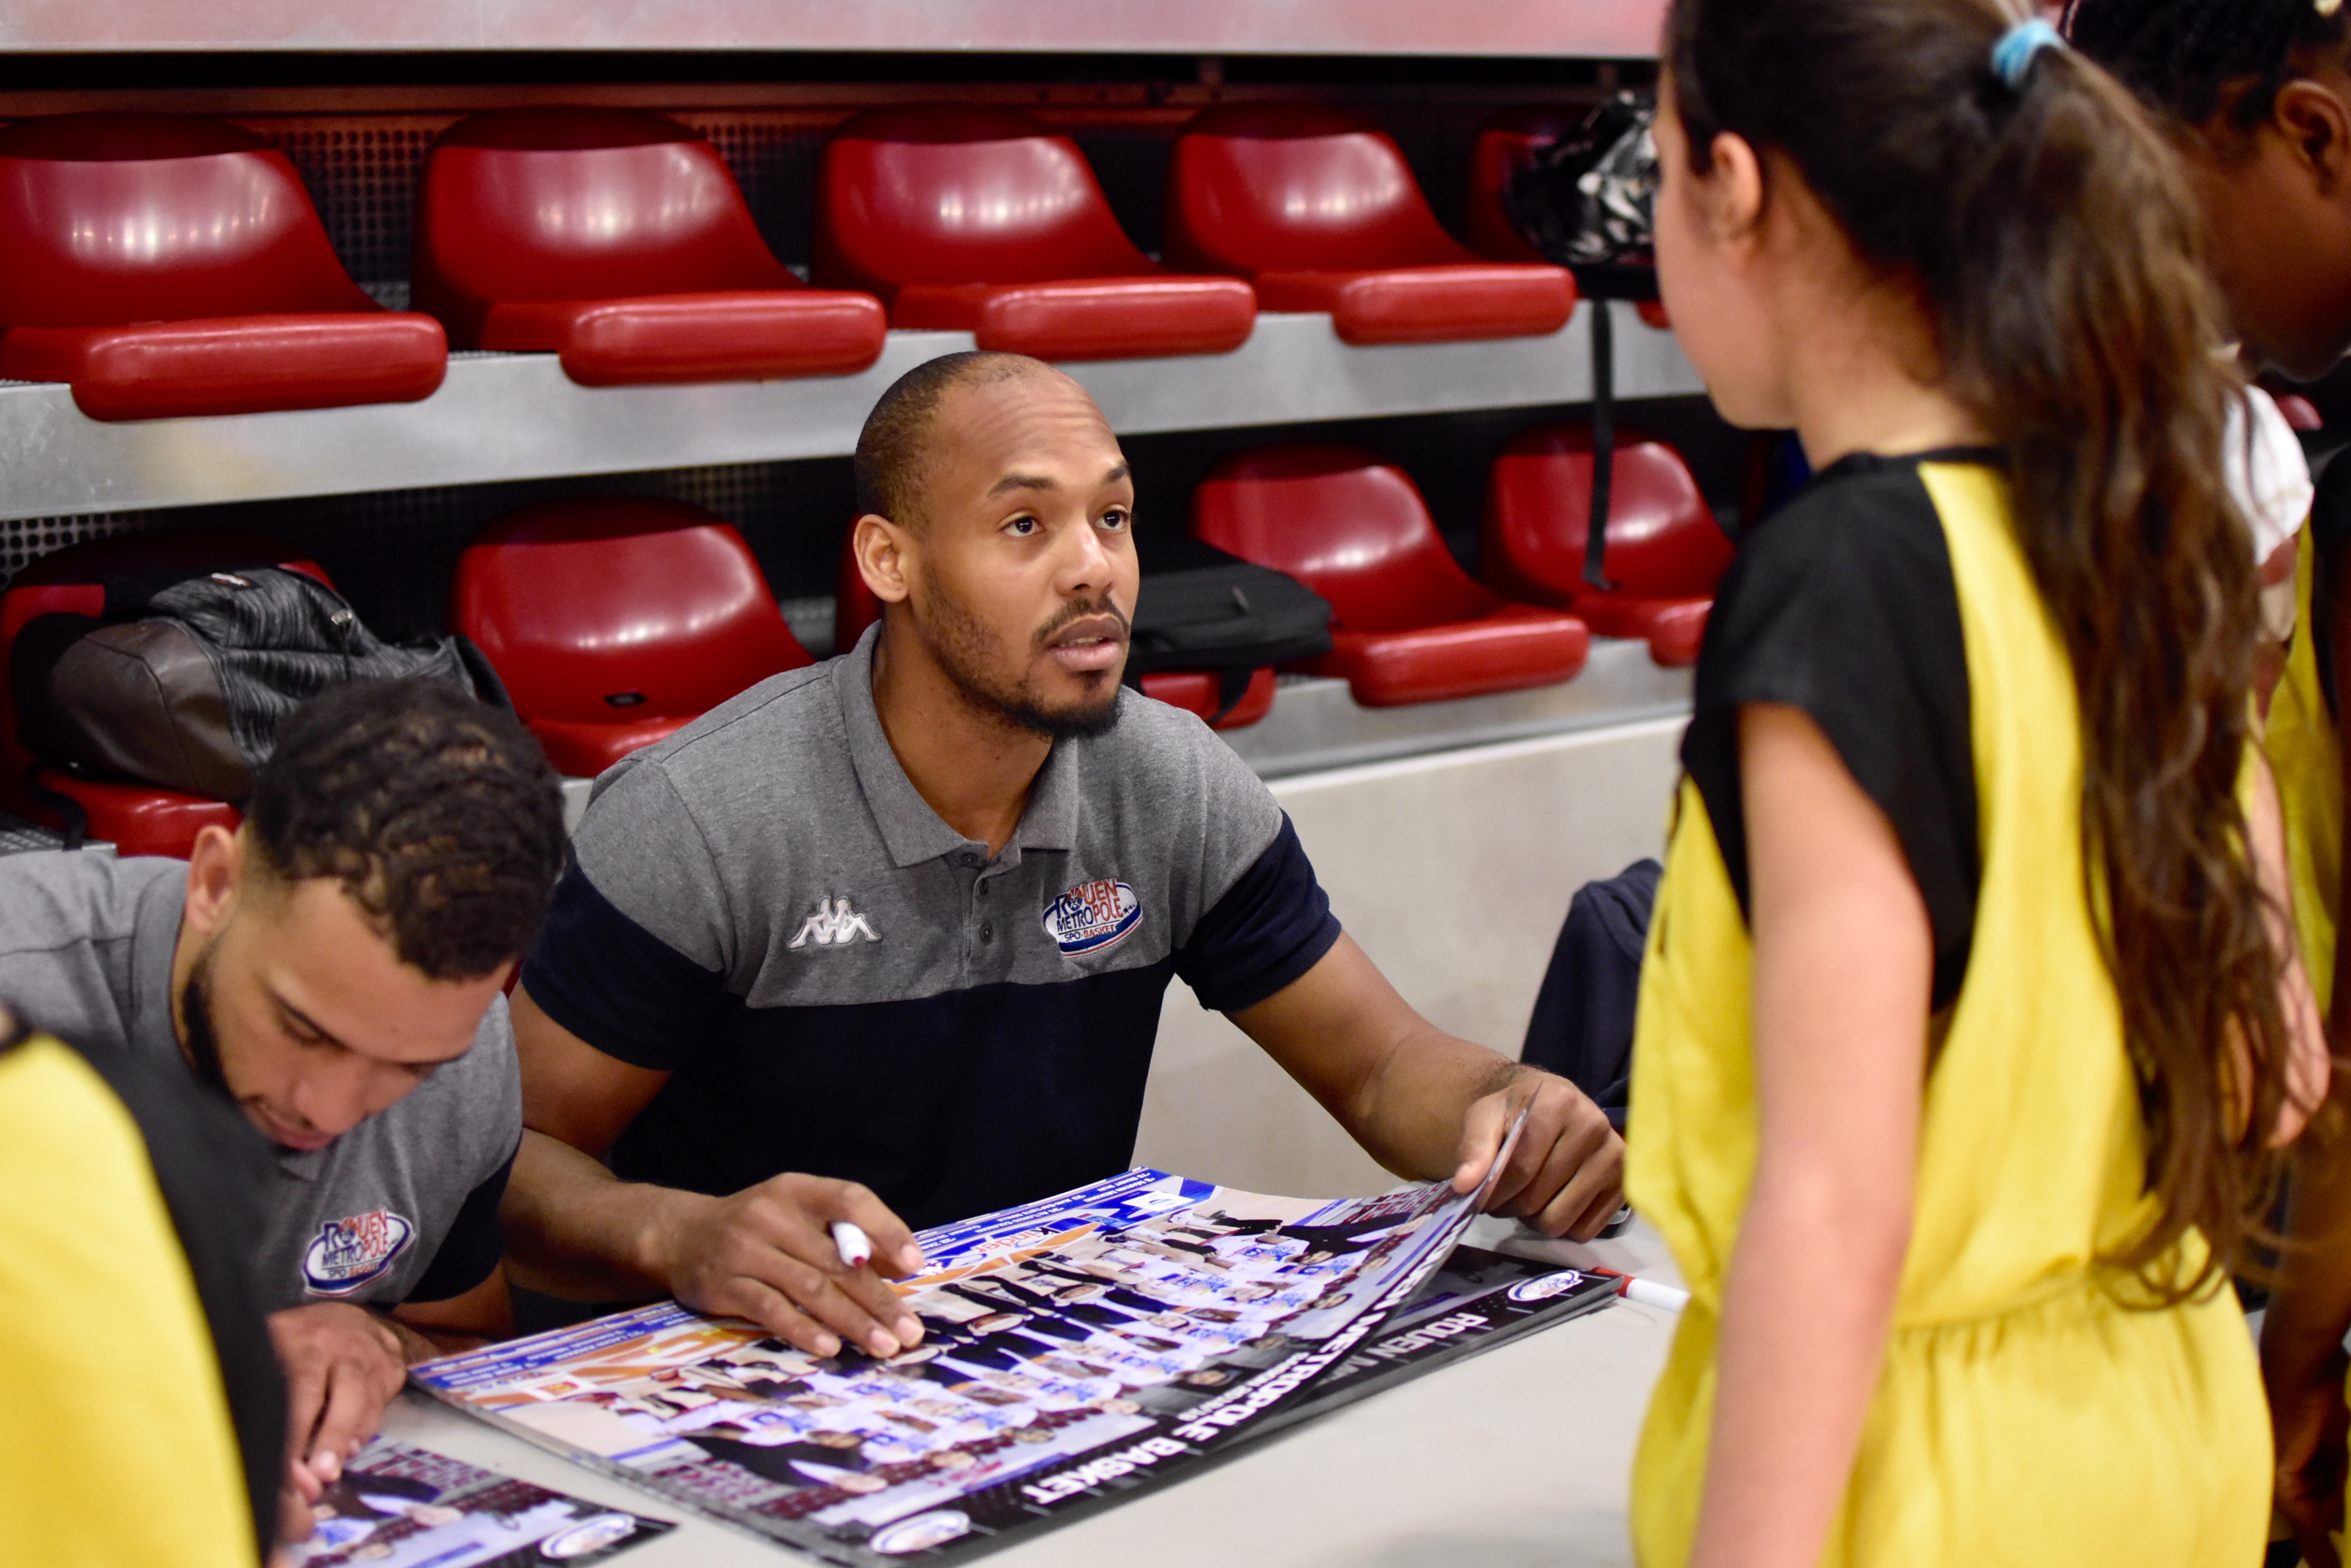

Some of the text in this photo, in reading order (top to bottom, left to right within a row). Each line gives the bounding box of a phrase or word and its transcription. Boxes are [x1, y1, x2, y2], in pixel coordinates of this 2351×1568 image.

[1055, 878, 1118, 919] ROUEN
[1056, 896, 1124, 933] METROPOLE
[322, 1232, 388, 1267] METROPOLE
[324, 1209, 388, 1252] ROUEN
[974, 1226, 1062, 1253] kinder
[1365, 1312, 1489, 1360] ROUEN
[1173, 1311, 1387, 1442] METROPOLE
[1021, 1436, 1189, 1505] BASKET
